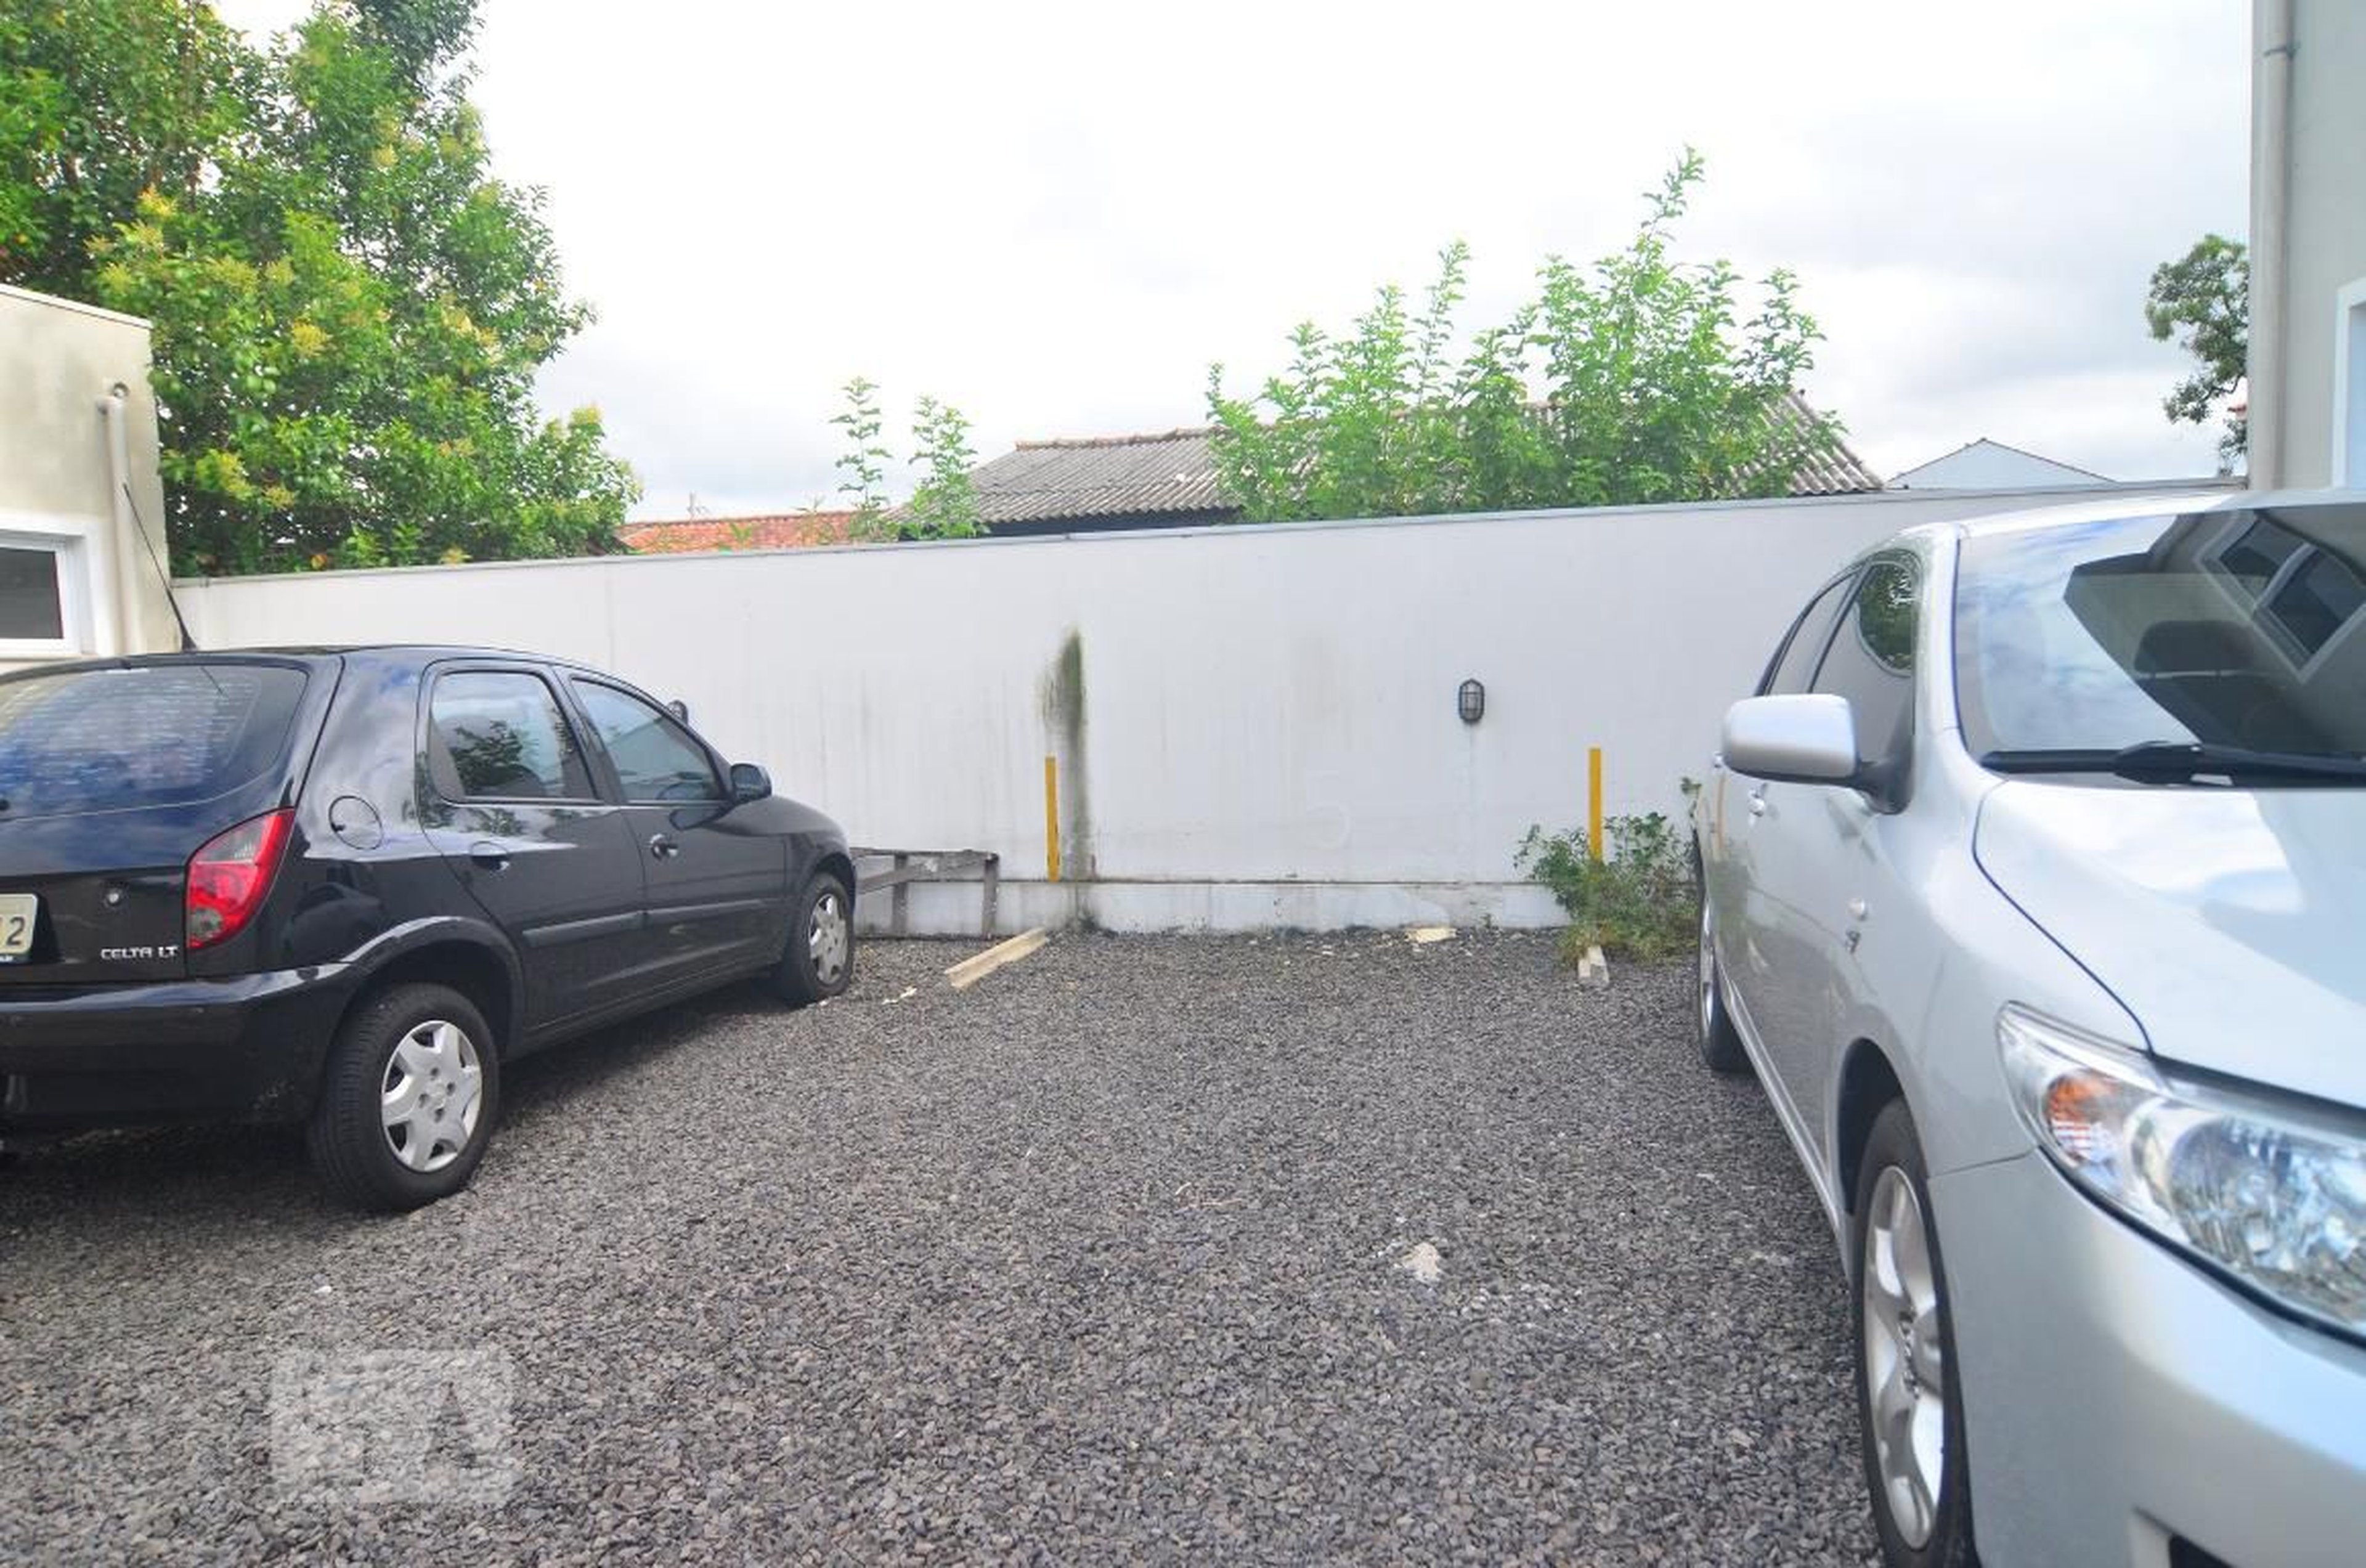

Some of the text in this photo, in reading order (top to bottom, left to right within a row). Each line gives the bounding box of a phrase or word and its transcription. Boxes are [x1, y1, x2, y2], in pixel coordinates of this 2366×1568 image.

[1305, 770, 1352, 850] 5
[0, 916, 26, 946] 2
[100, 945, 179, 960] CELTA LT
